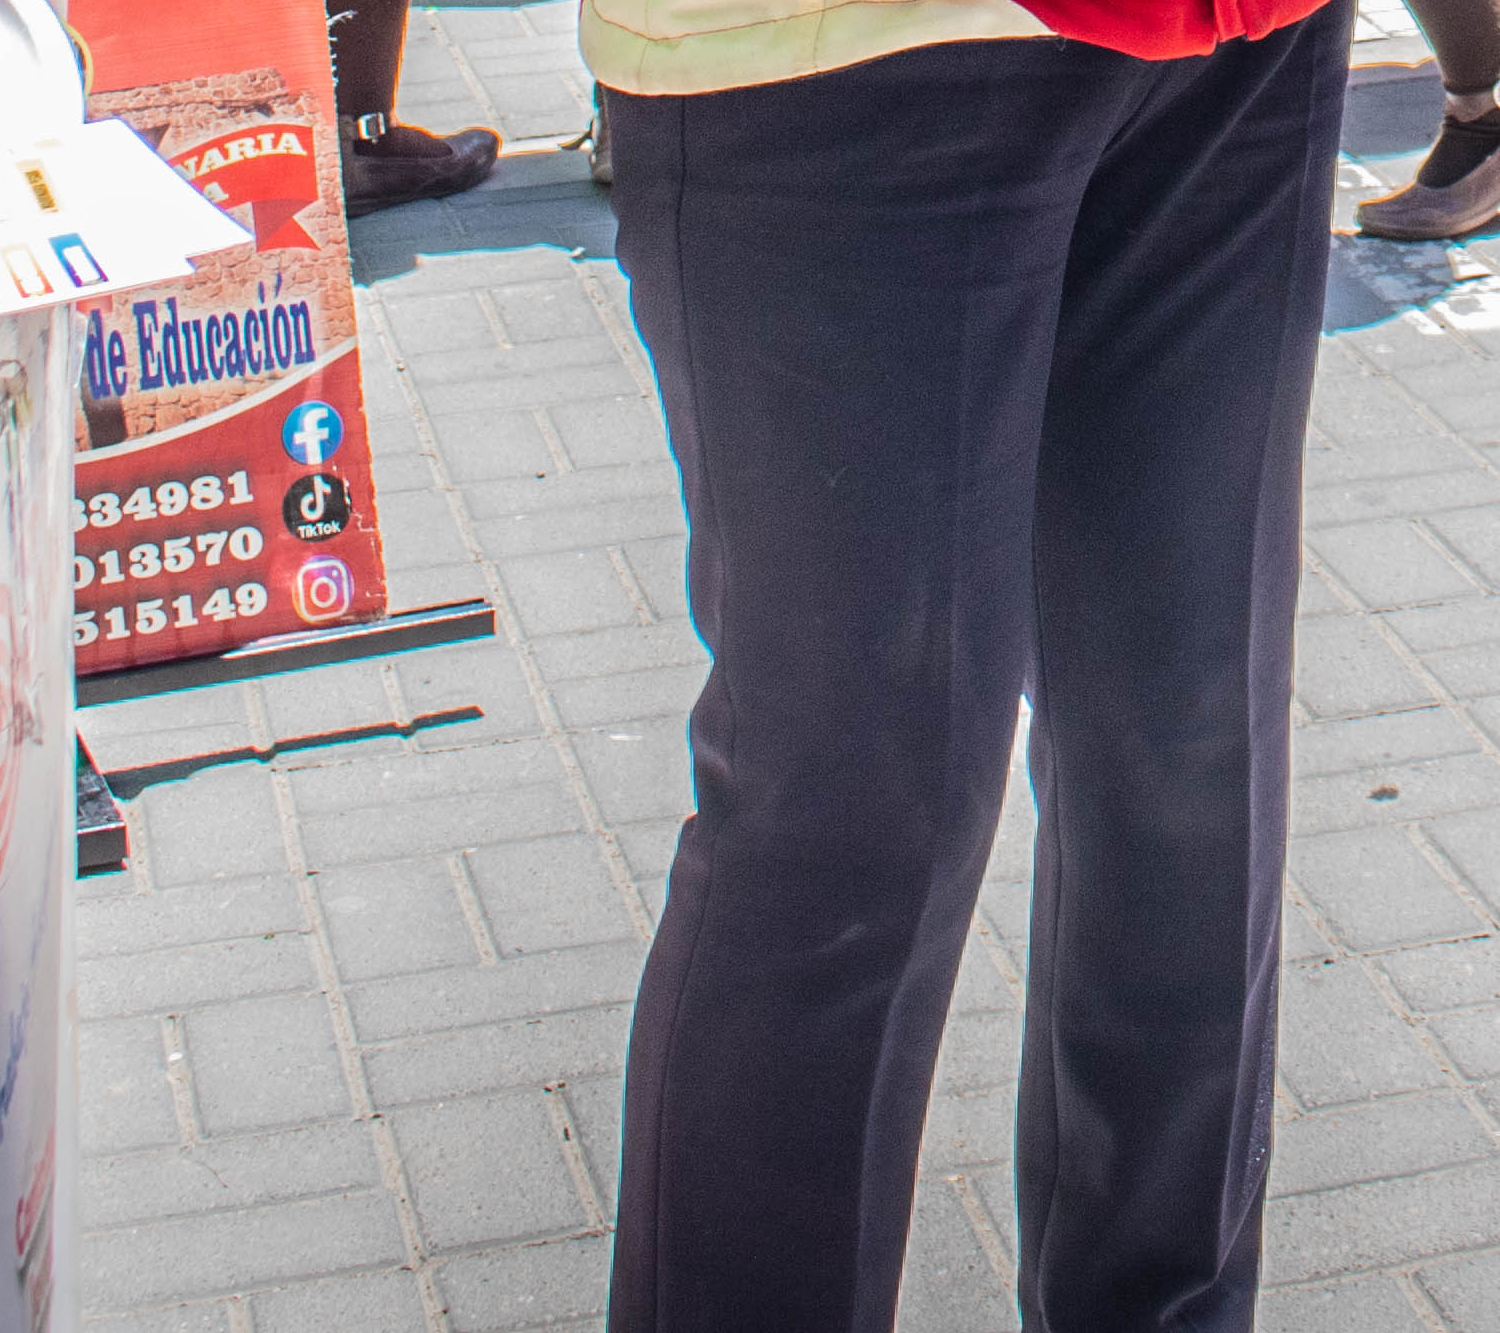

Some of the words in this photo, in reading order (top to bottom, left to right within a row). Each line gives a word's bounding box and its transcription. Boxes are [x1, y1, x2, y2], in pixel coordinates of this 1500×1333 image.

[85, 306, 127, 400] de
[132, 270, 316, 392] Educación
[297, 519, 341, 539] TikTok
